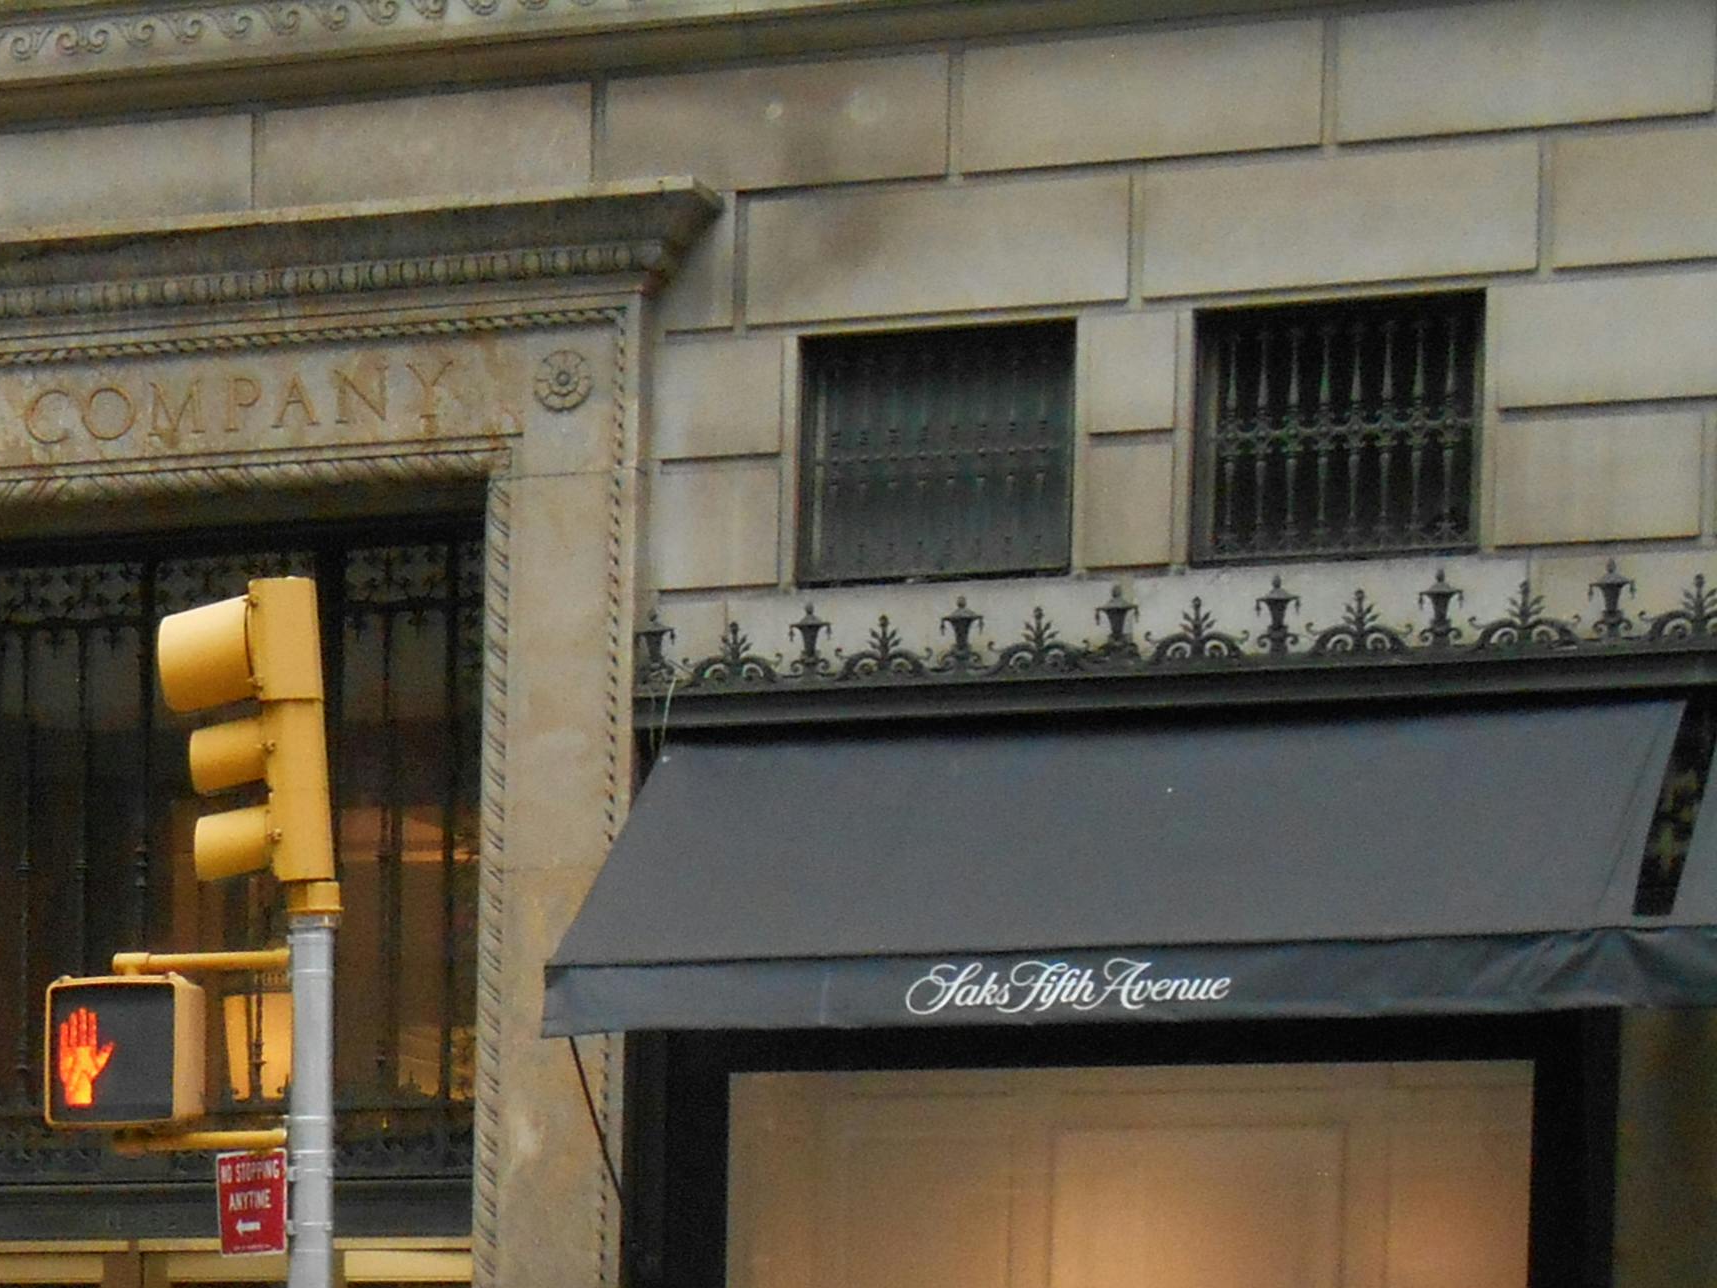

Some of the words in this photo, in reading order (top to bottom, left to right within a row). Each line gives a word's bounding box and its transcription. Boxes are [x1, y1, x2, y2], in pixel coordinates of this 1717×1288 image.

[24, 360, 454, 446] COMPANY
[906, 962, 1010, 1015] Saks
[996, 961, 1094, 1013] Fifth
[1073, 958, 1231, 1011] Avenue
[228, 1188, 272, 1211] ANYTIME
